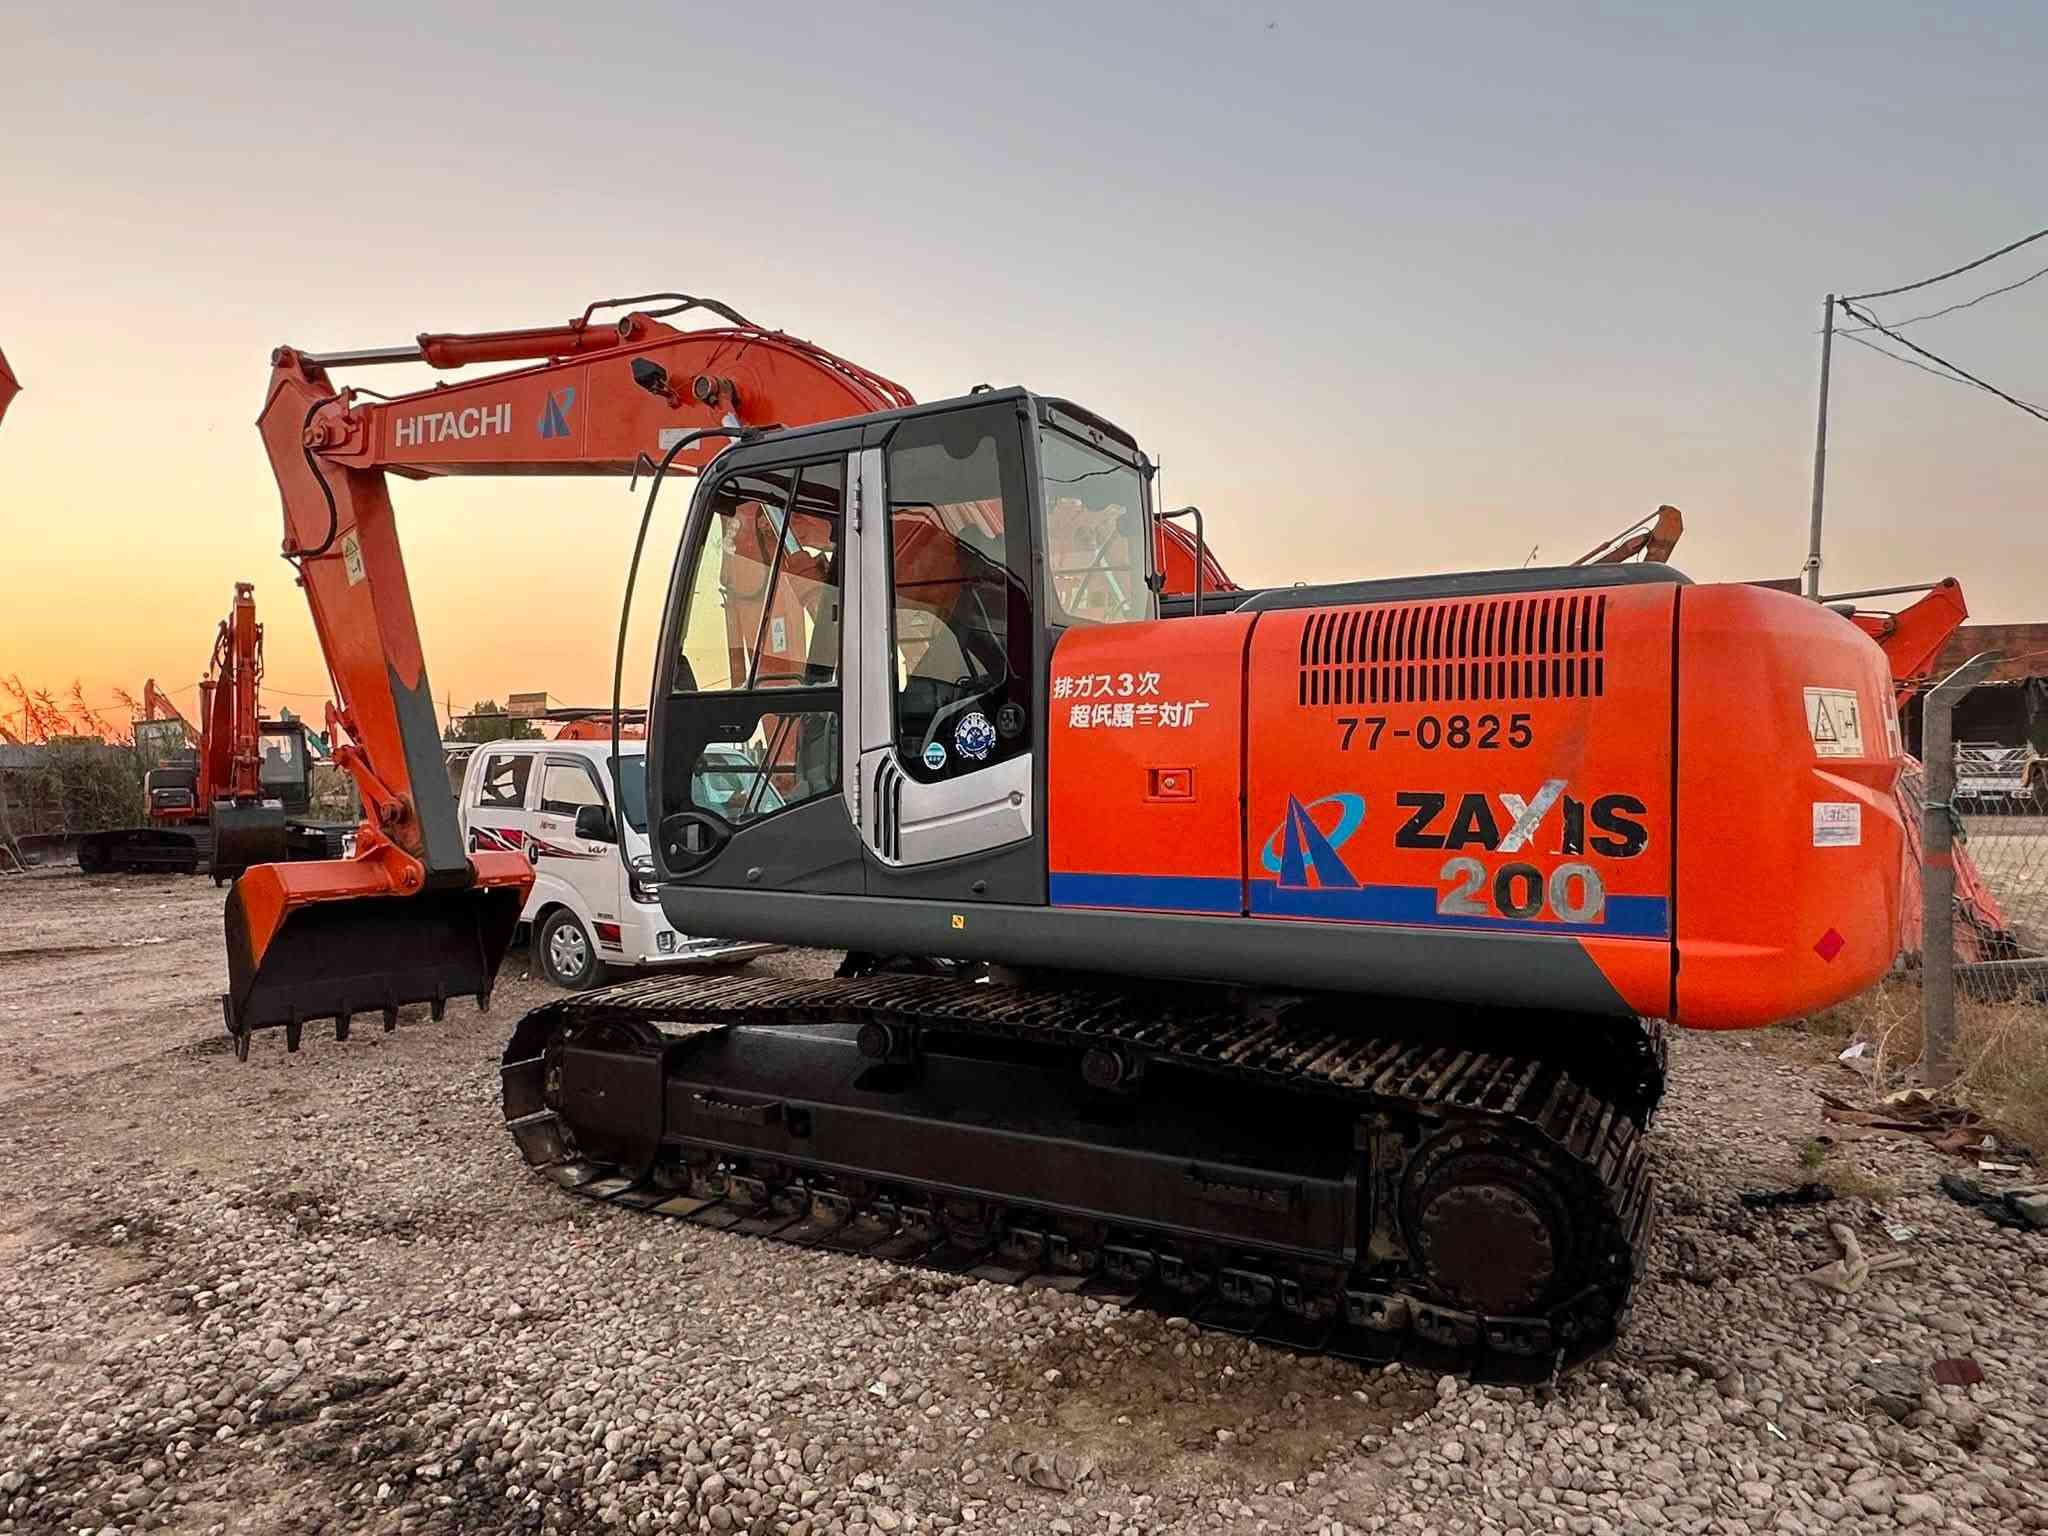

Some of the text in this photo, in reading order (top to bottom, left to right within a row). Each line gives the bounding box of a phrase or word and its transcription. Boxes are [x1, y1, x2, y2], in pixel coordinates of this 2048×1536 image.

[396, 403, 511, 447] HITACHI
[1053, 672, 1160, 698] 排ガス3次
[1337, 714, 1532, 750] 77-0825
[1394, 779, 1649, 859] ZAXIS
[1439, 857, 1602, 923] 200
